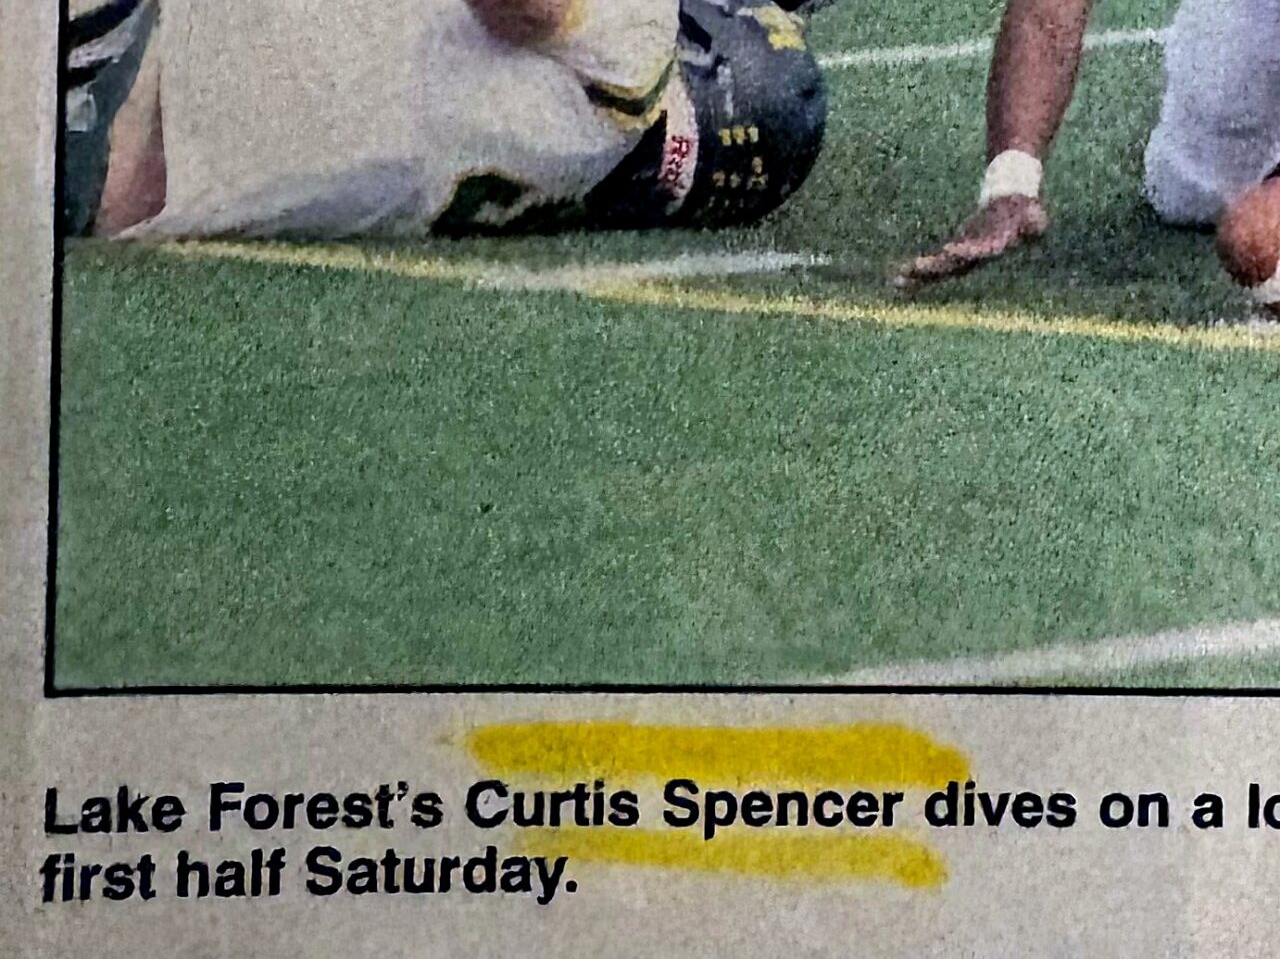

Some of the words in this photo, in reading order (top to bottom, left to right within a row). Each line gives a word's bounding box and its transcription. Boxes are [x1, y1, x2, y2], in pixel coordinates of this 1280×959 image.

[43, 783, 188, 839] Lake
[209, 780, 444, 832] Forest's
[464, 777, 640, 829] Curtis
[662, 778, 905, 841] Spencer
[924, 780, 1077, 829] dives
[1099, 792, 1170, 829] on
[1191, 793, 1224, 830] a
[38, 852, 157, 906] first
[176, 846, 287, 899] half
[304, 845, 578, 906] Saturday.
